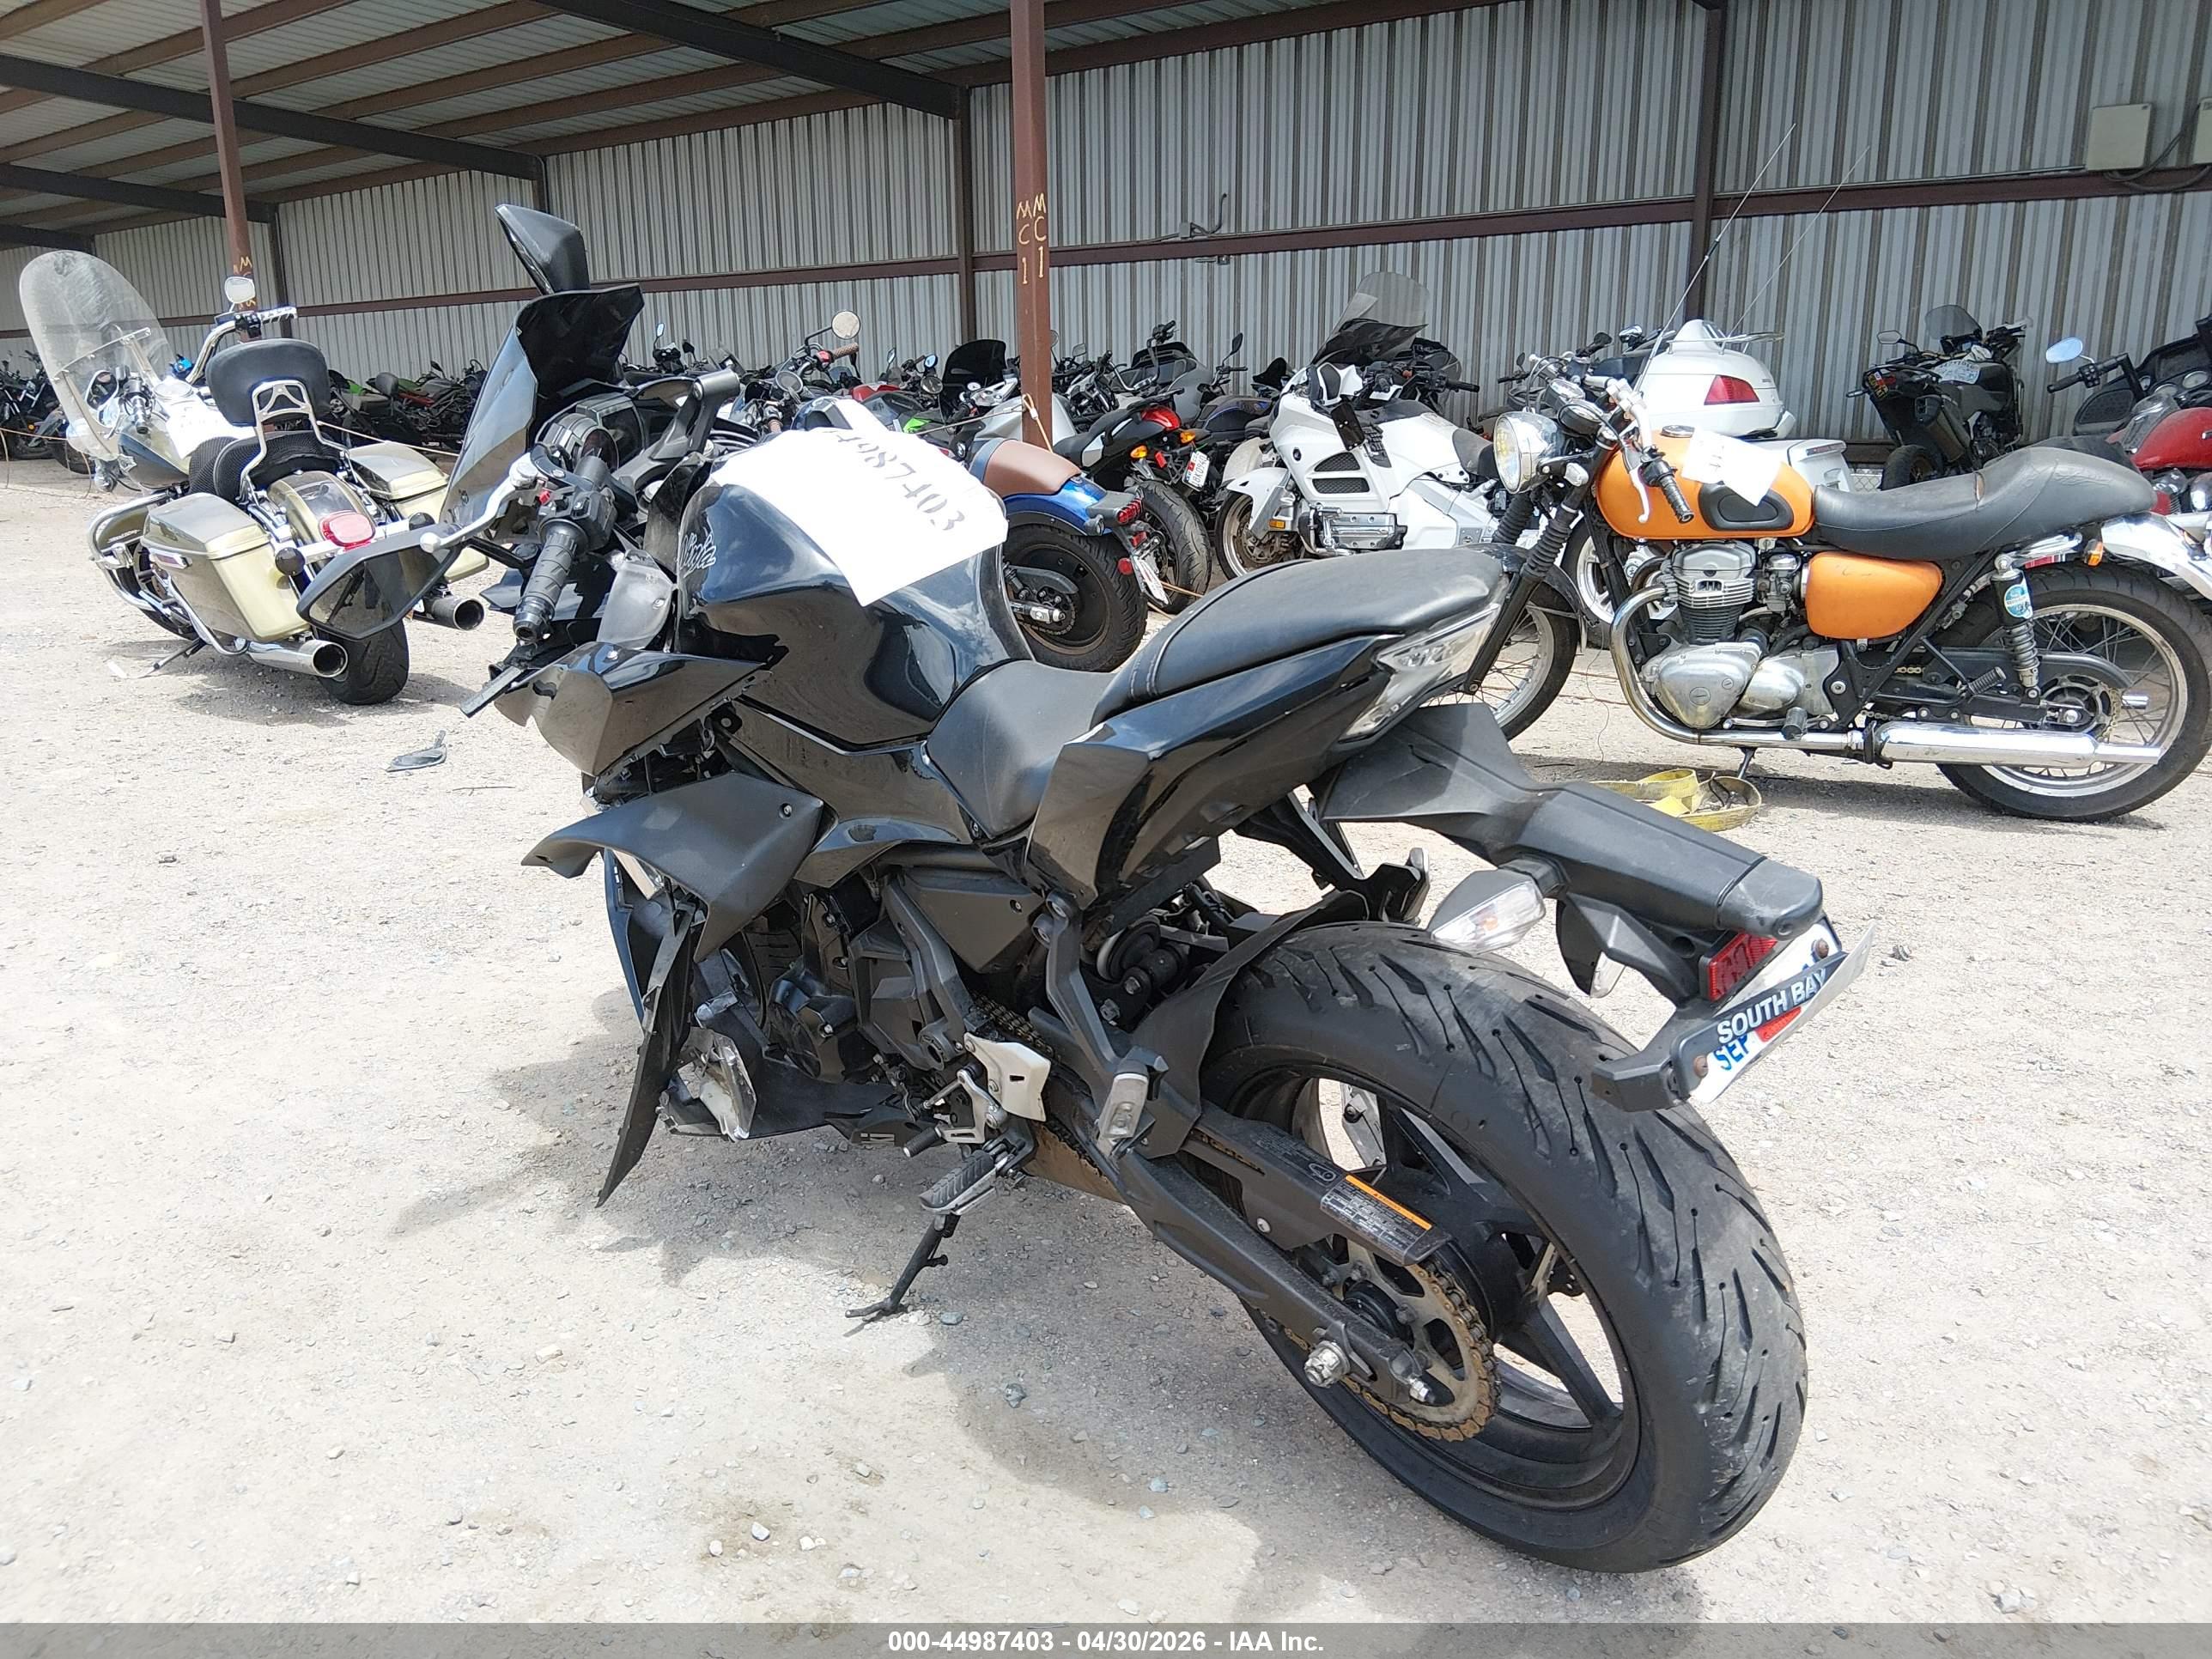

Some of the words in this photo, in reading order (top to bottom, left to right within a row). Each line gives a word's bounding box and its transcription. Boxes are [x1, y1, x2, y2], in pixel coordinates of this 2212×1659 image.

[823, 430, 966, 532] 4987403
[679, 532, 717, 578] Ninja
[1717, 989, 1788, 1043] SOUTH
[1790, 968, 1826, 1006] BAY
[1713, 1033, 1750, 1071] SEP
